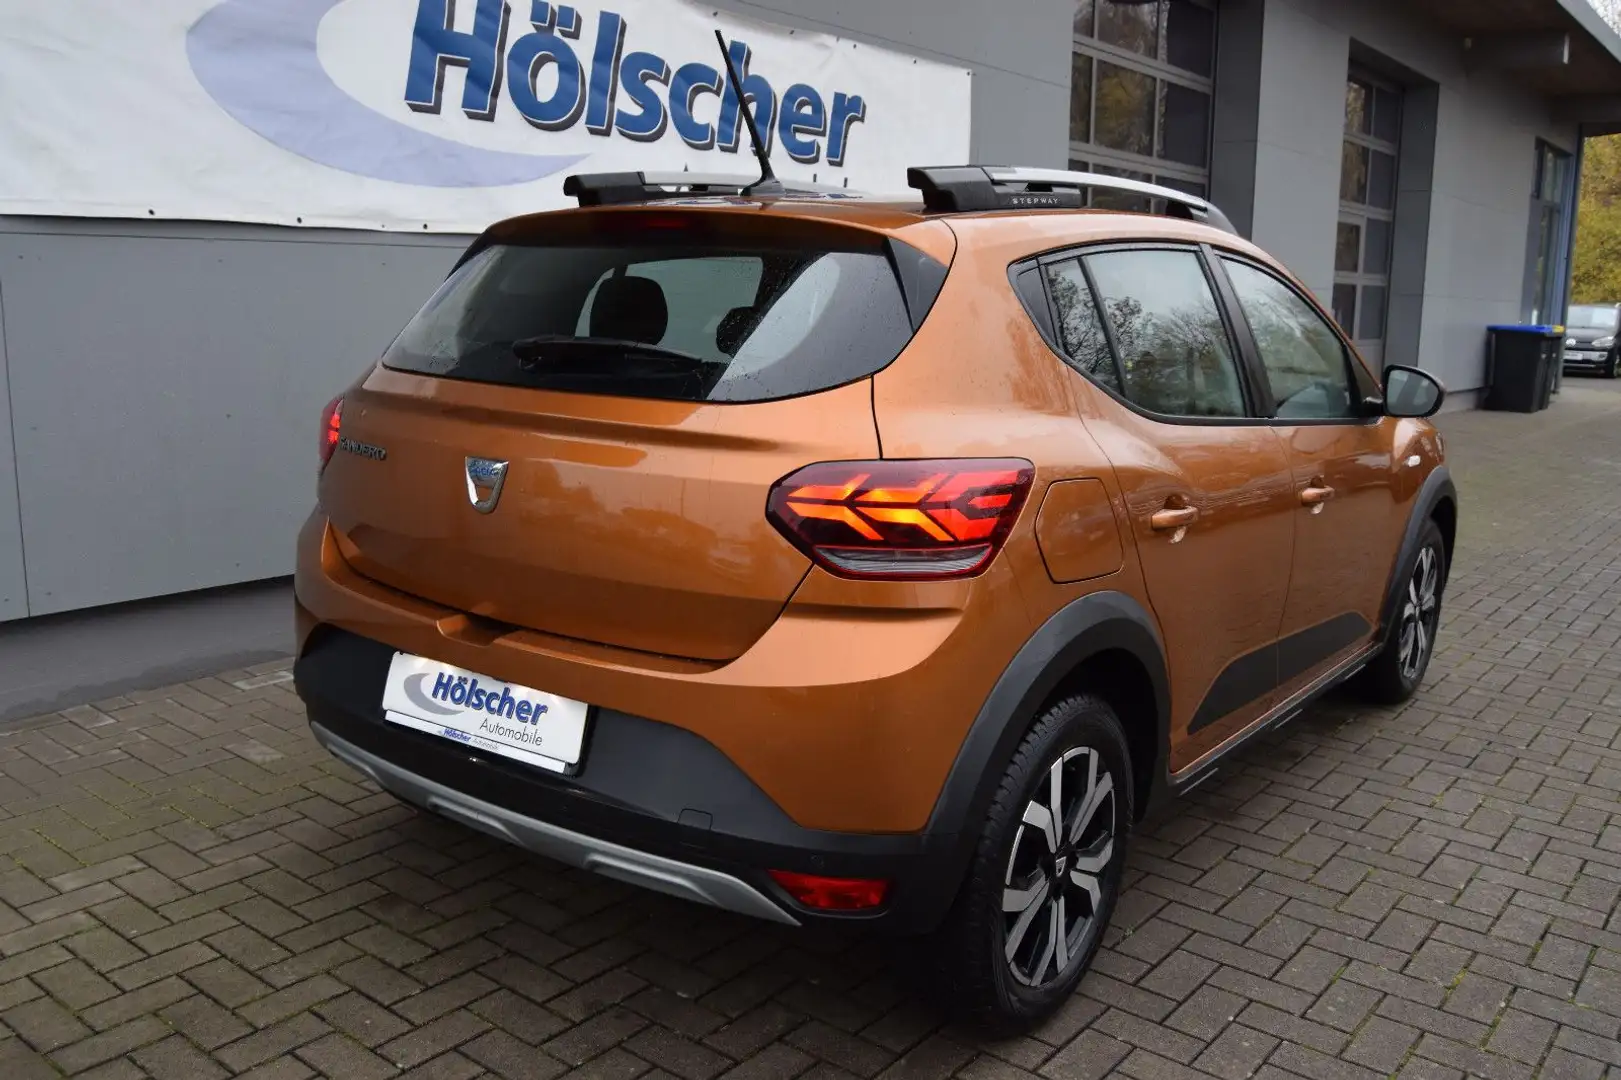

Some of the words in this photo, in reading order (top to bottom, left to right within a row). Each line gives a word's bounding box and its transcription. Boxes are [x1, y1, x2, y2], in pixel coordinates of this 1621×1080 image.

[404, 0, 866, 167] Hölscher
[432, 672, 548, 725] Hölscher
[444, 728, 472, 742] Hölscher
[480, 719, 542, 746] Automobile
